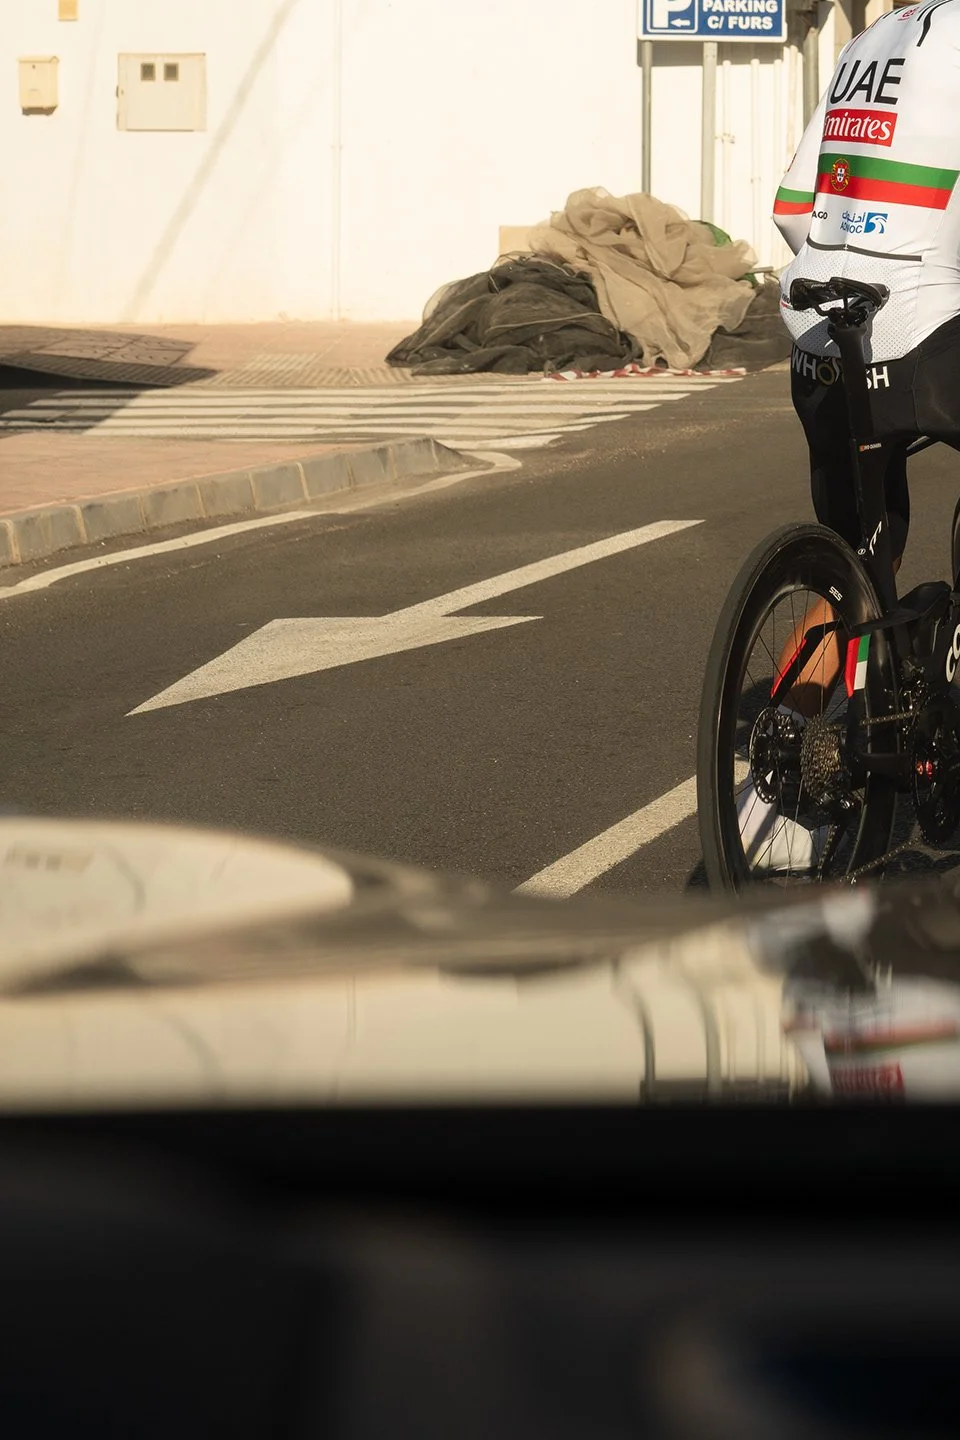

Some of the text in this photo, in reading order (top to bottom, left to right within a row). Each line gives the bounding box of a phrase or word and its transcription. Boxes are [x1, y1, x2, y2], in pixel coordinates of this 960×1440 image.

[702, 0, 778, 13] PARKING
[707, 16, 773, 29] C/ FURS
[830, 58, 906, 105] UAE
